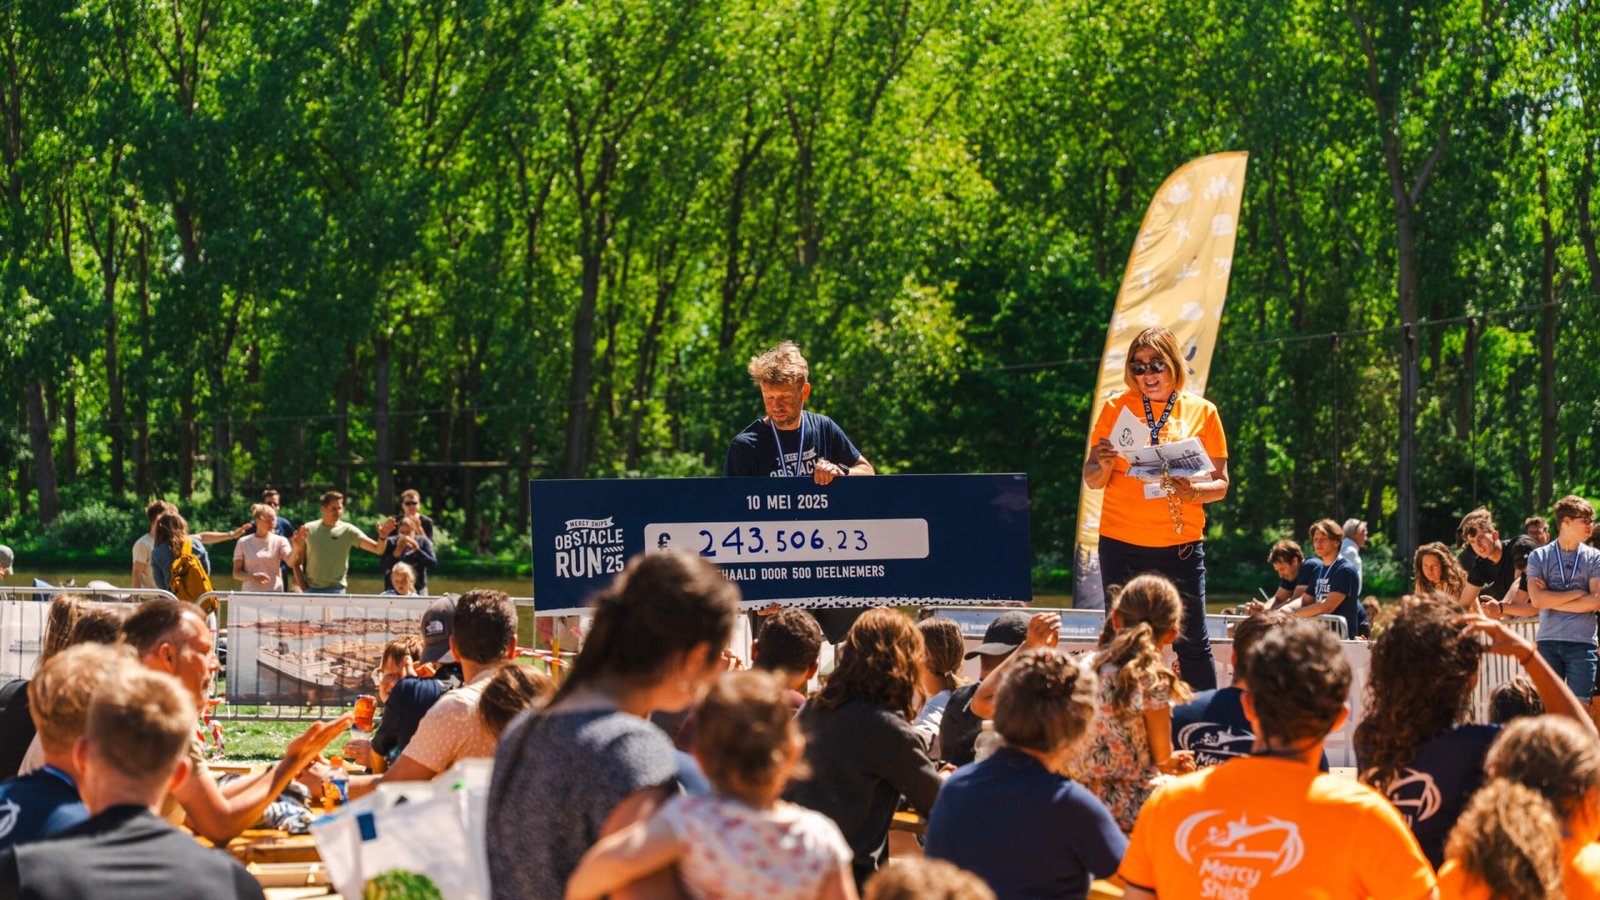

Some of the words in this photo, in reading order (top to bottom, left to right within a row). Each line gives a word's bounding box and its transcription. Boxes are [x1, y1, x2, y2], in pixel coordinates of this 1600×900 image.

[746, 495, 760, 510] 10
[767, 495, 791, 510] MEI
[797, 494, 828, 509] 2025
[554, 528, 624, 550] OBSTACLE
[555, 546, 602, 578] RUN
[717, 568, 757, 581] HAALD
[761, 567, 788, 580] DOOR
[792, 567, 811, 579] 500
[816, 565, 885, 579] DEELNEMERS
[1199, 858, 1261, 889] Mercy
